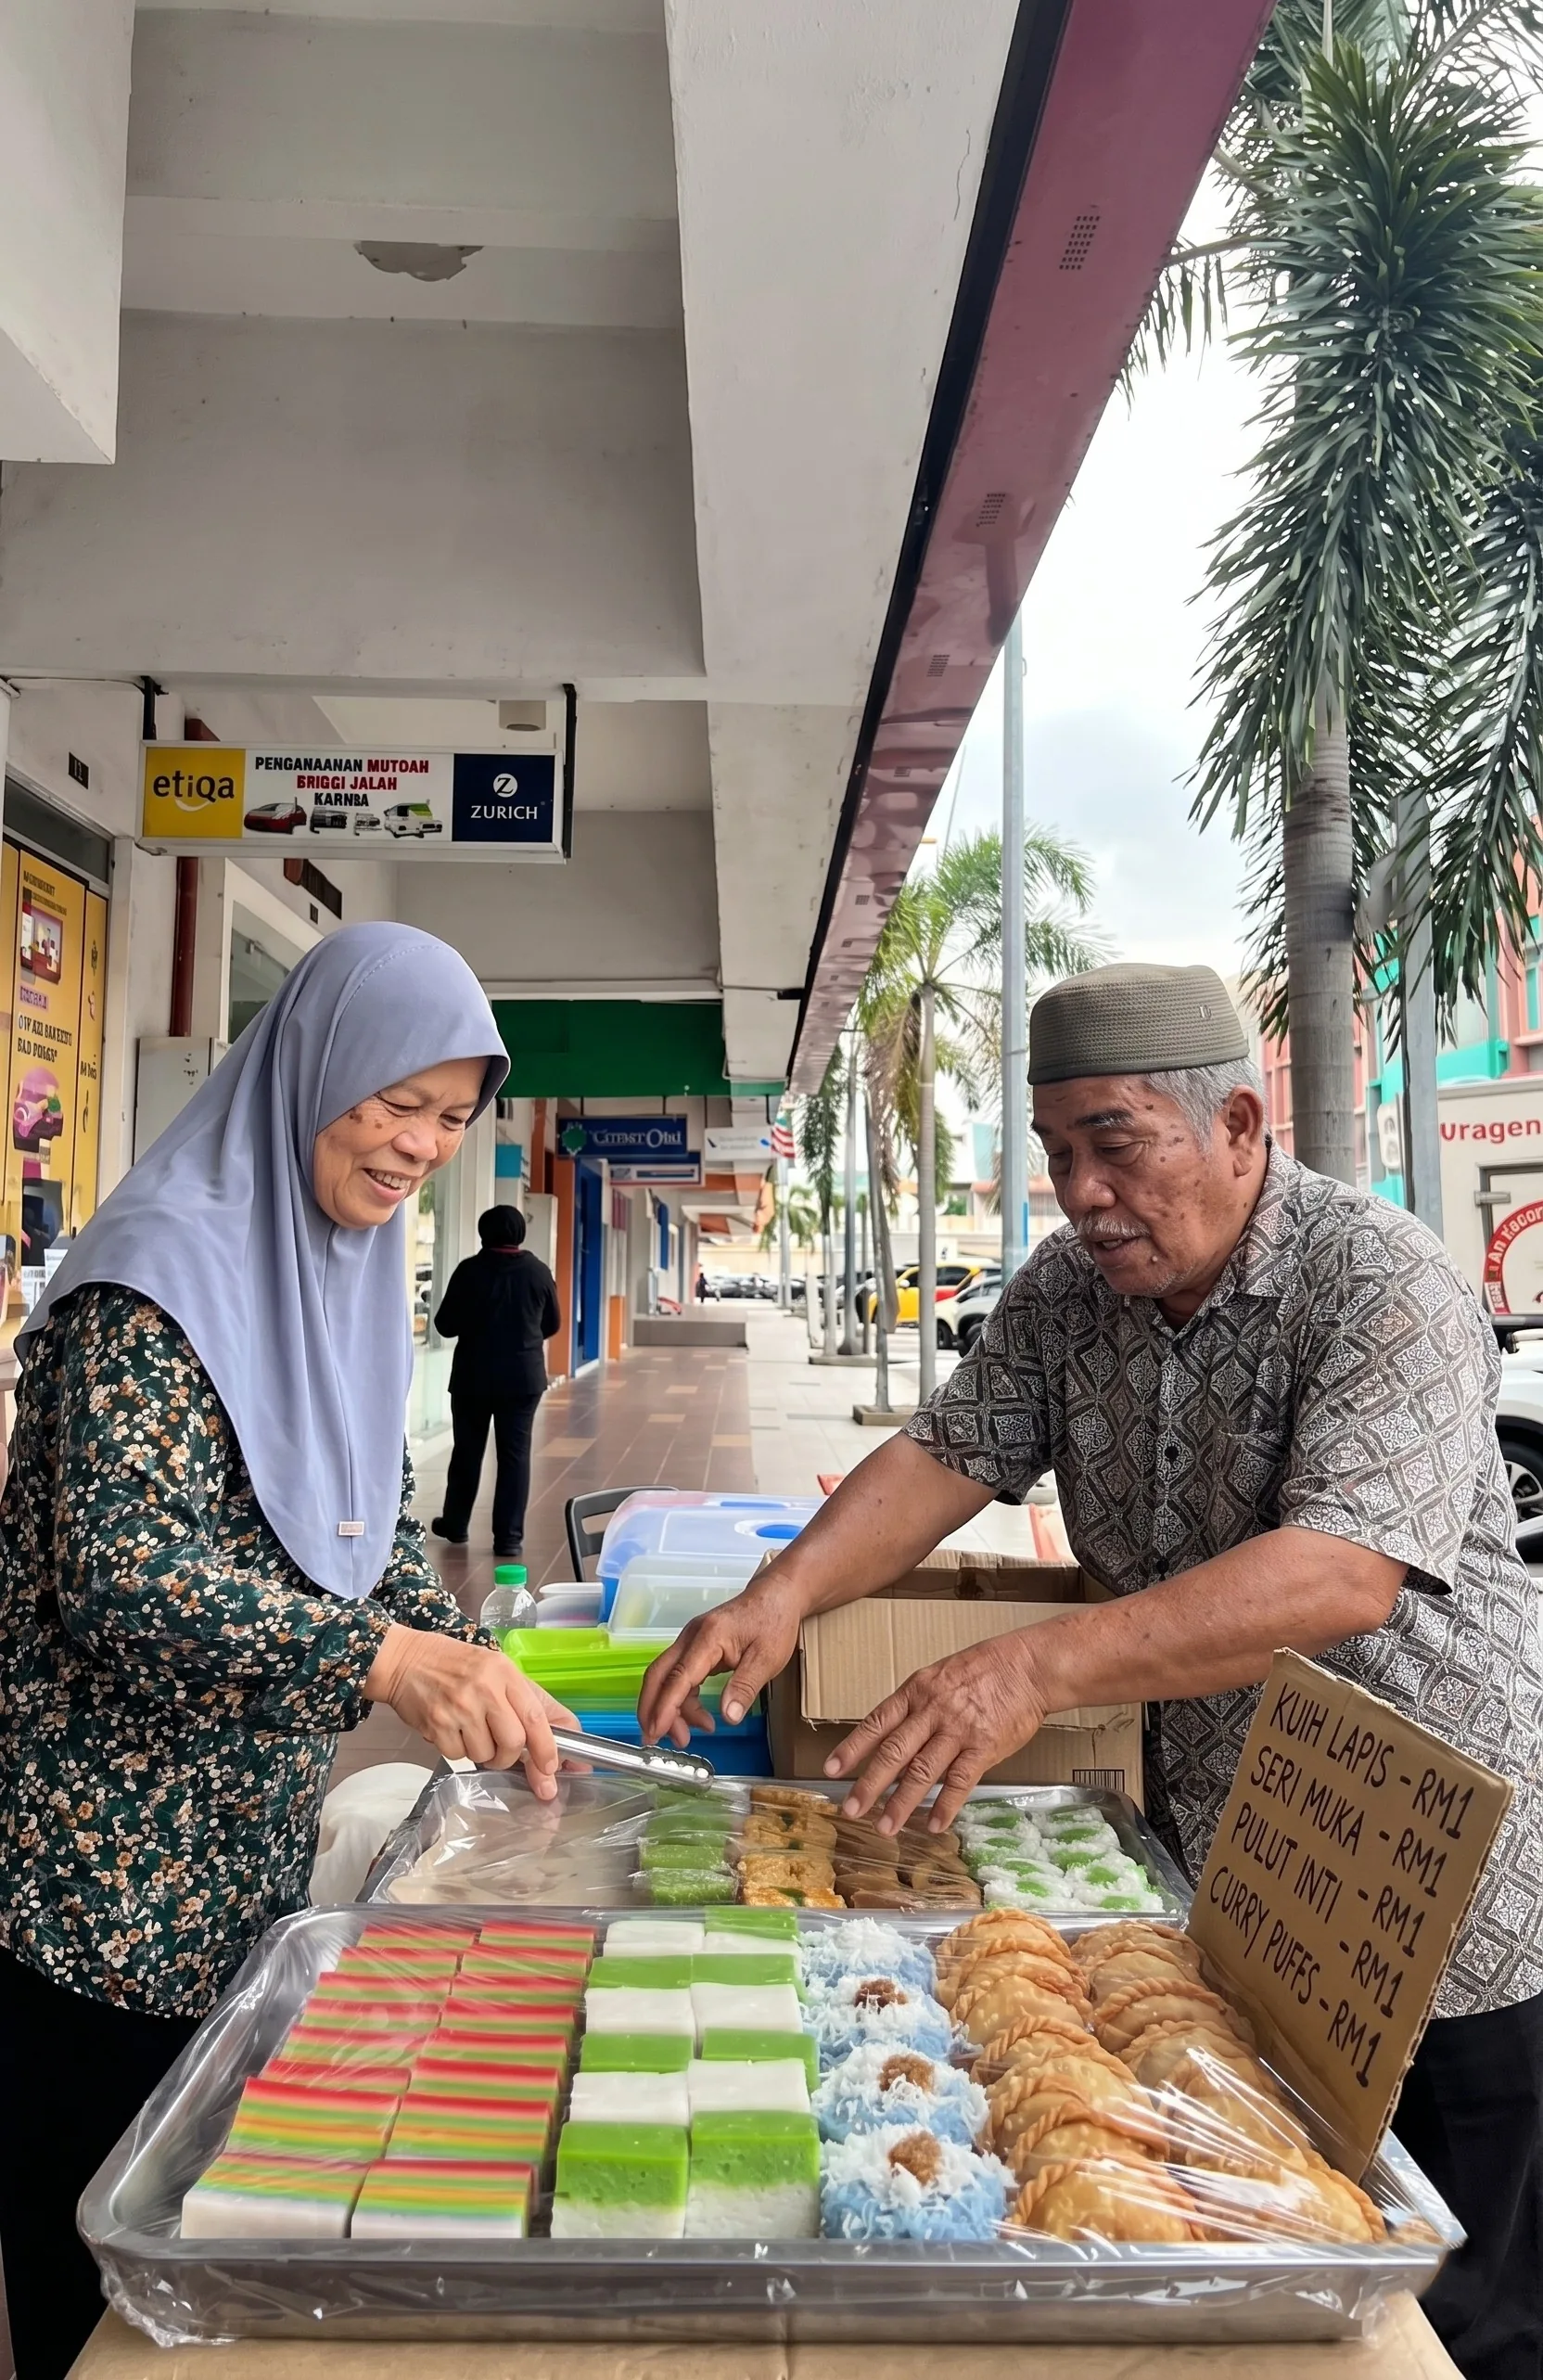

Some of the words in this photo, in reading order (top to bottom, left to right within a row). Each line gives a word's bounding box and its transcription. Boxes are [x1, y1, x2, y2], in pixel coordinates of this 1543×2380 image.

[255, 756, 363, 773] PENGANAANAN
[367, 759, 429, 774] MUTOAH
[350, 776, 398, 790] JALAH
[470, 805, 538, 820] ZURICH
[1269, 1683, 1330, 1747] KUIH
[1326, 1716, 1395, 1788] LAPIS
[1250, 1745, 1303, 1808] SERI
[1299, 1777, 1365, 1856] MUKA
[1231, 1801, 1298, 1881] PULUT
[1293, 1854, 1344, 1925] INTI
[1210, 1866, 1270, 1960] CURRY
[1262, 1919, 1321, 2005] PUFFS
